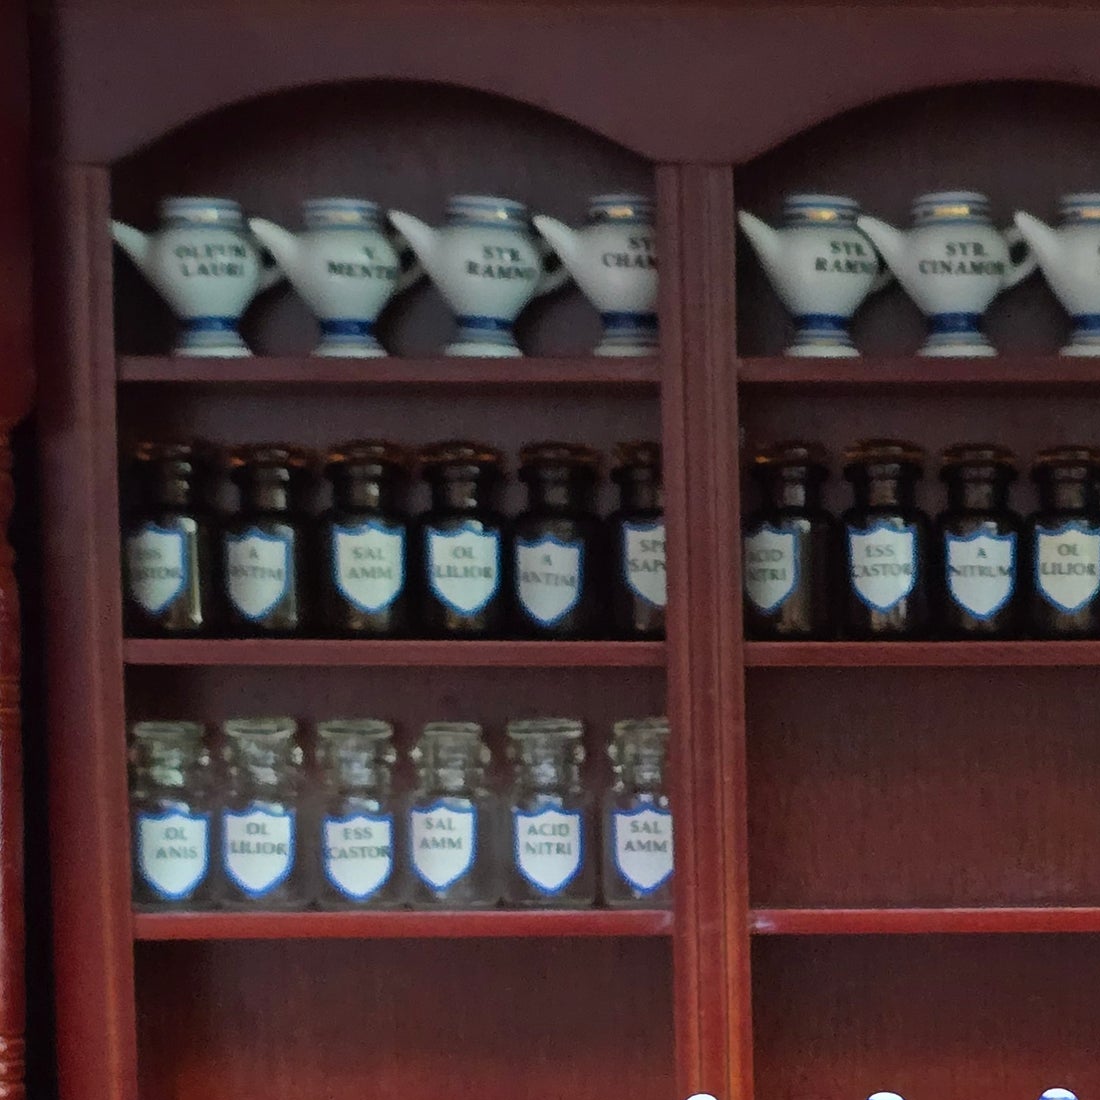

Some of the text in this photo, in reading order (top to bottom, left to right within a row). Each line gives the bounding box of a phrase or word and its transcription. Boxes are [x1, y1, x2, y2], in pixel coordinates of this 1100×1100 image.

[353, 547, 383, 561] SAL
[865, 544, 895, 558] ESS
[348, 566, 393, 580] AMM
[246, 822, 269, 836] OL
[424, 817, 456, 831] SAL
[527, 823, 570, 837] ACID
[630, 820, 662, 834] SAL
[164, 826, 188, 841] OL
[342, 827, 373, 841] ESS
[420, 837, 463, 850] AMM
[525, 842, 572, 856] NITRI
[624, 839, 669, 853] AMM
